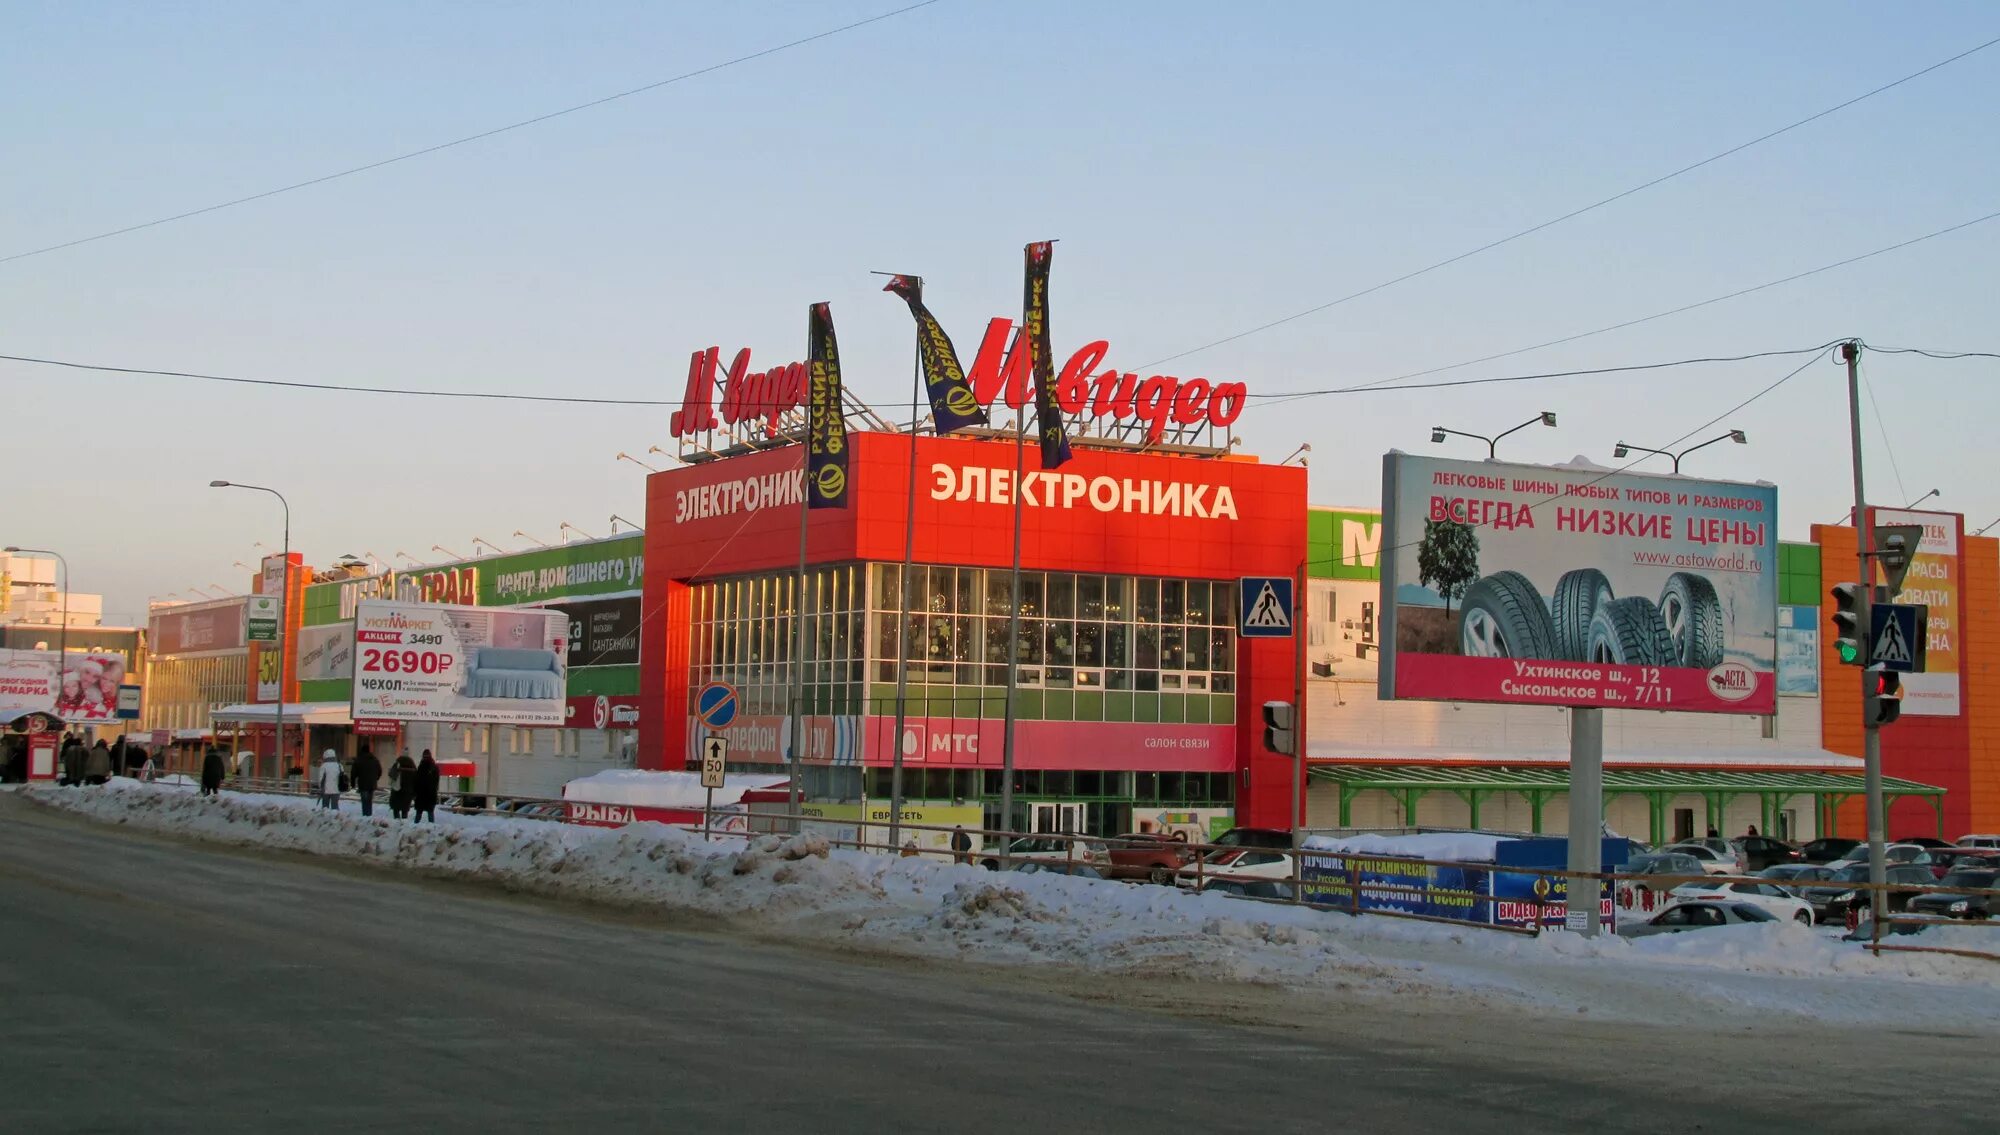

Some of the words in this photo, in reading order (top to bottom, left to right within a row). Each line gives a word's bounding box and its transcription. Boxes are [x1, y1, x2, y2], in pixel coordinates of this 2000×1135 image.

[811, 360, 827, 455] РУССКИЙ
[675, 468, 809, 524] ЭЛЕКТРОНИК
[930, 463, 1239, 520] ЭЛЕКТРОНИКА
[1432, 472, 1506, 491] ЛЕГКОВЫЕ
[1512, 480, 1559, 496] ШИНЫ
[1564, 484, 1620, 500] ЛЮБЫХ
[1625, 489, 1671, 505] ТИПОВ
[1677, 493, 1687, 506] И
[1693, 494, 1763, 512] РАЗМЕРОВ
[1429, 495, 1535, 530] ВСЕГДА
[1556, 507, 1672, 539] НИЗКИЕ
[1687, 517, 1764, 547] ЦЕНЫ
[1632, 549, 1762, 571] www.astaworld.ru
[497, 570, 535, 597] центр
[539, 559, 624, 592] домашнего
[363, 633, 397, 641] АКЦИЯ
[409, 633, 443, 645] 3490
[592, 638, 636, 651] САНТЕХНИКИ
[1513, 660, 1602, 681] Ухтинское
[1608, 669, 1632, 685] ш.,
[1641, 668, 1661, 684] 12
[1724, 669, 1746, 687] АСТА
[361, 678, 402, 691] чехол
[1500, 679, 1596, 699] Сысольское
[1603, 681, 1628, 701] ш.,
[1634, 685, 1672, 703] 7/11
[931, 733, 978, 753] МТС
[1144, 738, 1176, 749] салон
[1179, 738, 1210, 749] связи
[706, 760, 721, 772] 50
[571, 802, 639, 823] РЫБА
[872, 810, 923, 821] ЕВРСЕТЬ
